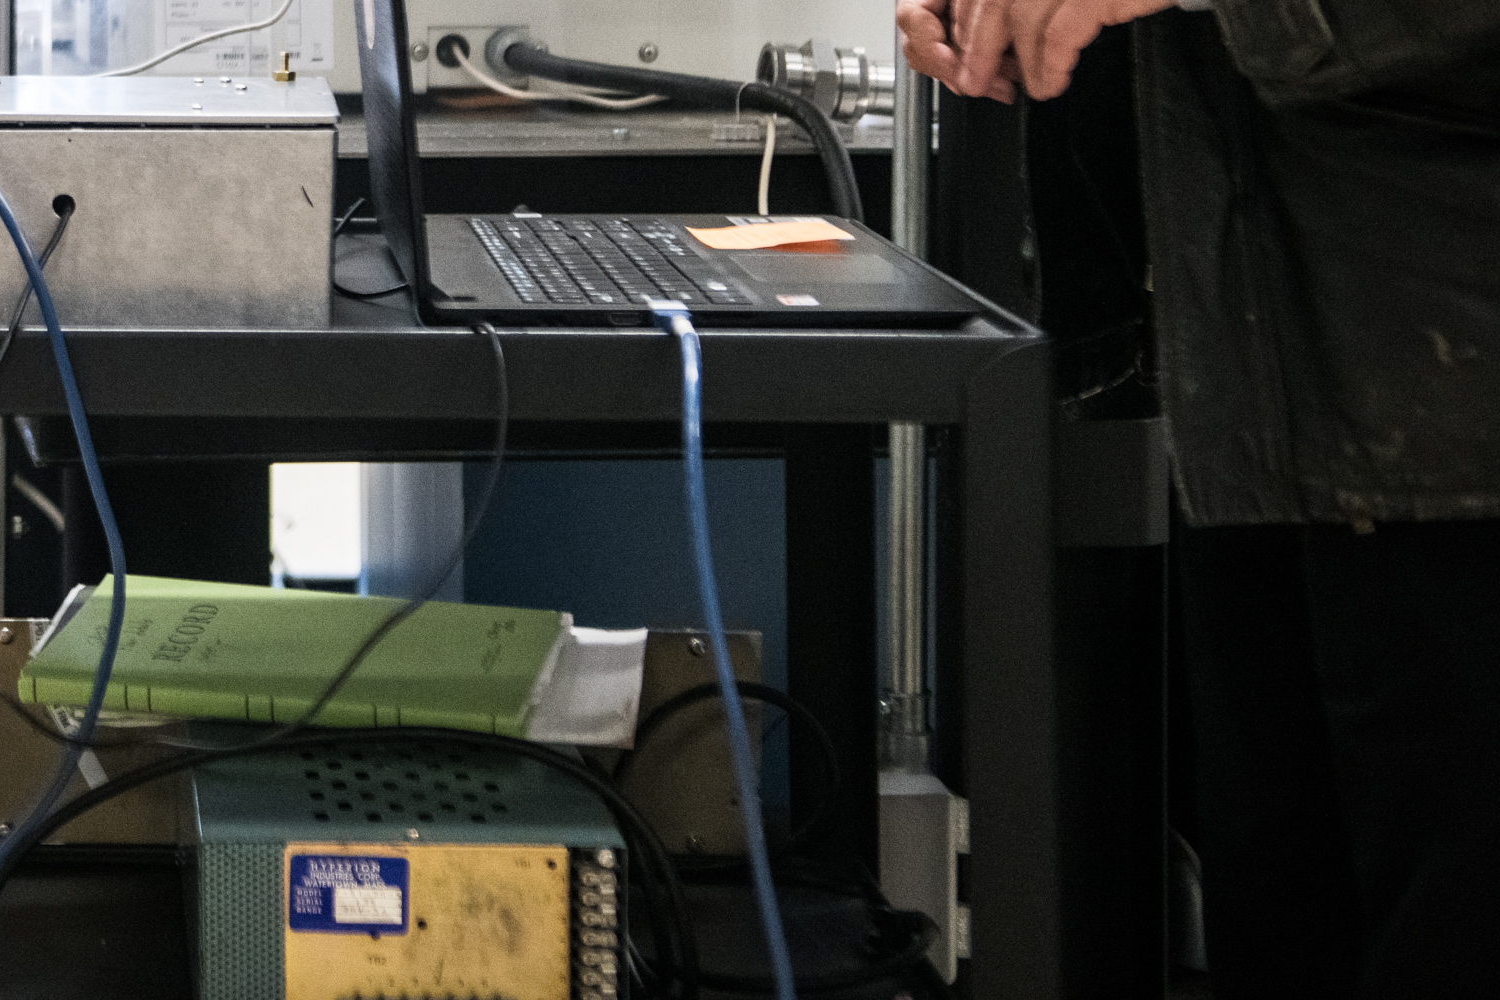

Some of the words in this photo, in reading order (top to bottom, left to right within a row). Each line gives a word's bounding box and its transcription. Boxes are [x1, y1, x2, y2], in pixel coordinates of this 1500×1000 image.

[152, 604, 219, 662] RECORD
[310, 862, 381, 873] HYPERION
[310, 872, 355, 880] INDUSTRIES
[304, 880, 358, 889] WATERTOWN
[296, 889, 323, 897] MODEL
